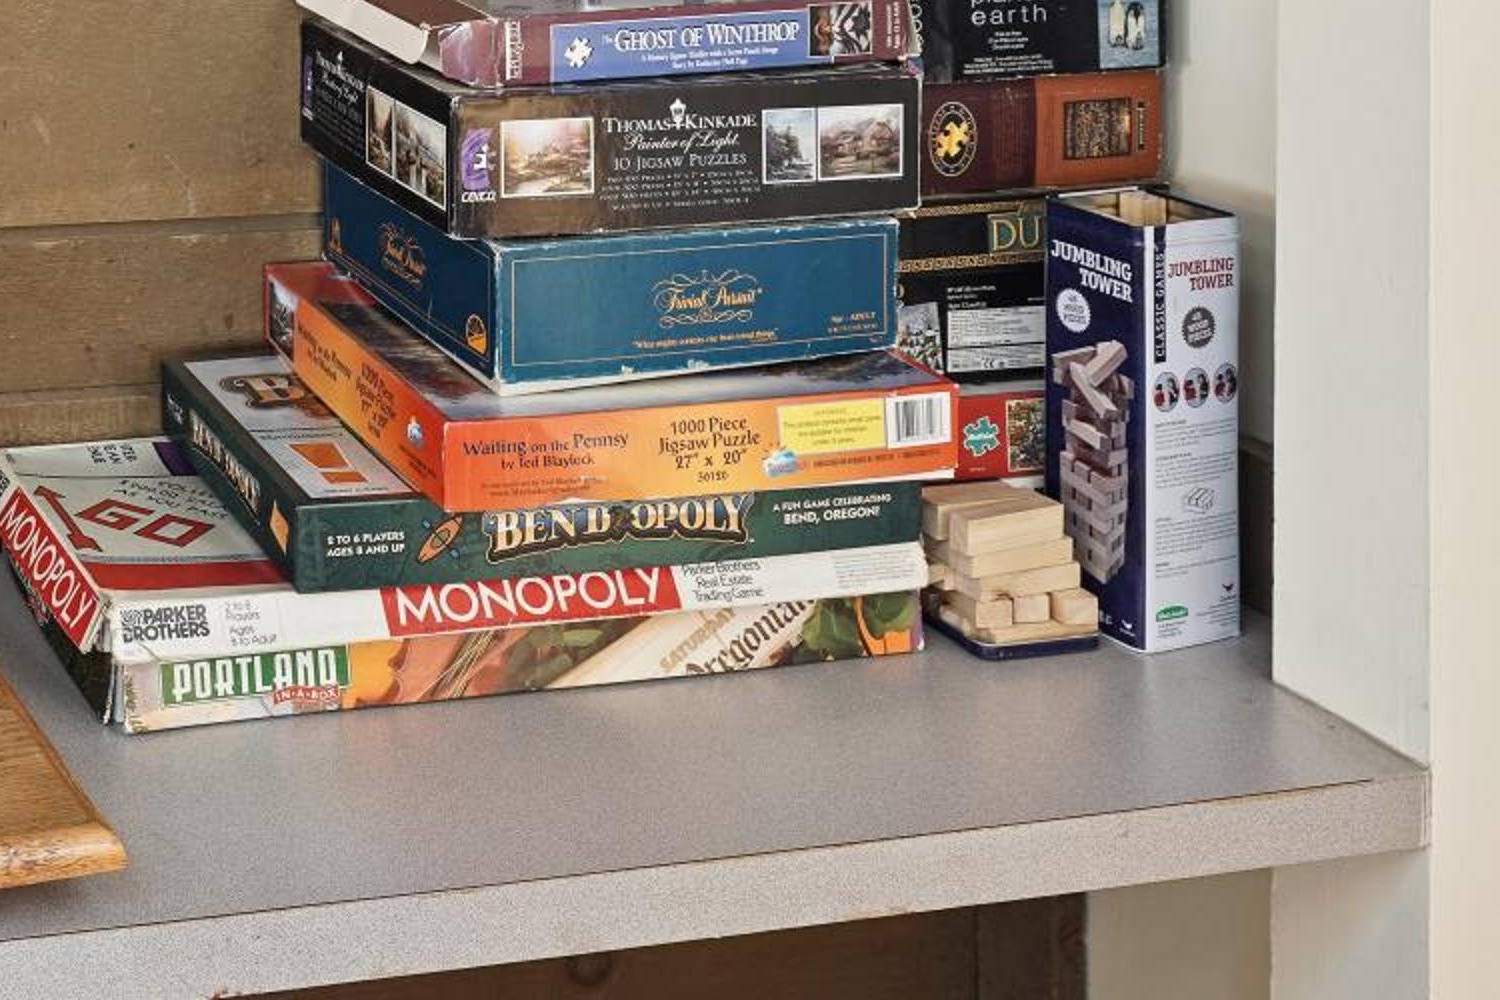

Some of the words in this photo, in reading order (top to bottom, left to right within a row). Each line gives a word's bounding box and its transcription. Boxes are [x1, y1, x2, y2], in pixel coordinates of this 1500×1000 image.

[971, 4, 1048, 26] earth
[614, 28, 678, 53] GHOST
[680, 26, 703, 48] OF
[704, 20, 800, 46] WINTHROP
[602, 117, 672, 133] THOMAS
[685, 113, 758, 129] KINKADE
[623, 132, 678, 151] Painter
[678, 131, 697, 154] of
[635, 155, 685, 172] JIGSAW
[689, 153, 747, 168] PUZZLES
[1051, 239, 1133, 282] JUMBLING
[1167, 257, 1235, 279] JUMBLING
[1079, 267, 1134, 303] TOWER
[1155, 253, 1165, 298] GAMES
[1189, 273, 1235, 291] TOWER
[665, 289, 709, 312] Trivial
[1155, 302, 1165, 357] CLASSIC
[669, 418, 706, 436] 1000
[708, 415, 748, 433] Piece
[462, 438, 527, 457] Waiting
[529, 442, 548, 452] on
[550, 439, 570, 452] the
[573, 432, 629, 450] Pennsy
[658, 436, 709, 457] Jigsaw
[711, 431, 761, 449] Puzzle
[500, 459, 516, 471] by
[518, 457, 540, 469] Ted
[543, 453, 596, 469] Blaylock
[772, 503, 780, 512] A
[781, 500, 801, 510] FUN
[803, 498, 831, 509] GAME
[832, 493, 893, 508] CELEBRATING
[74, 498, 215, 549] GO
[783, 511, 820, 525] BEND,
[823, 507, 881, 522] OREGON!
[336, 534, 351, 545] TO
[362, 531, 405, 543] PLAYERS
[326, 546, 354, 557] AGES
[364, 544, 389, 554] AND
[390, 543, 406, 553] UP
[0, 497, 98, 629] MONOPOLY
[715, 560, 761, 574] Brothers
[696, 575, 719, 587] Real
[720, 573, 753, 586] Estate
[395, 567, 660, 627] MONOPOLY
[693, 587, 732, 602] Trading
[732, 586, 764, 600] Game
[143, 604, 207, 626] PARKER
[123, 621, 211, 643] BROTHERS
[251, 633, 277, 645] Adult
[172, 650, 337, 702] PORTLAND
